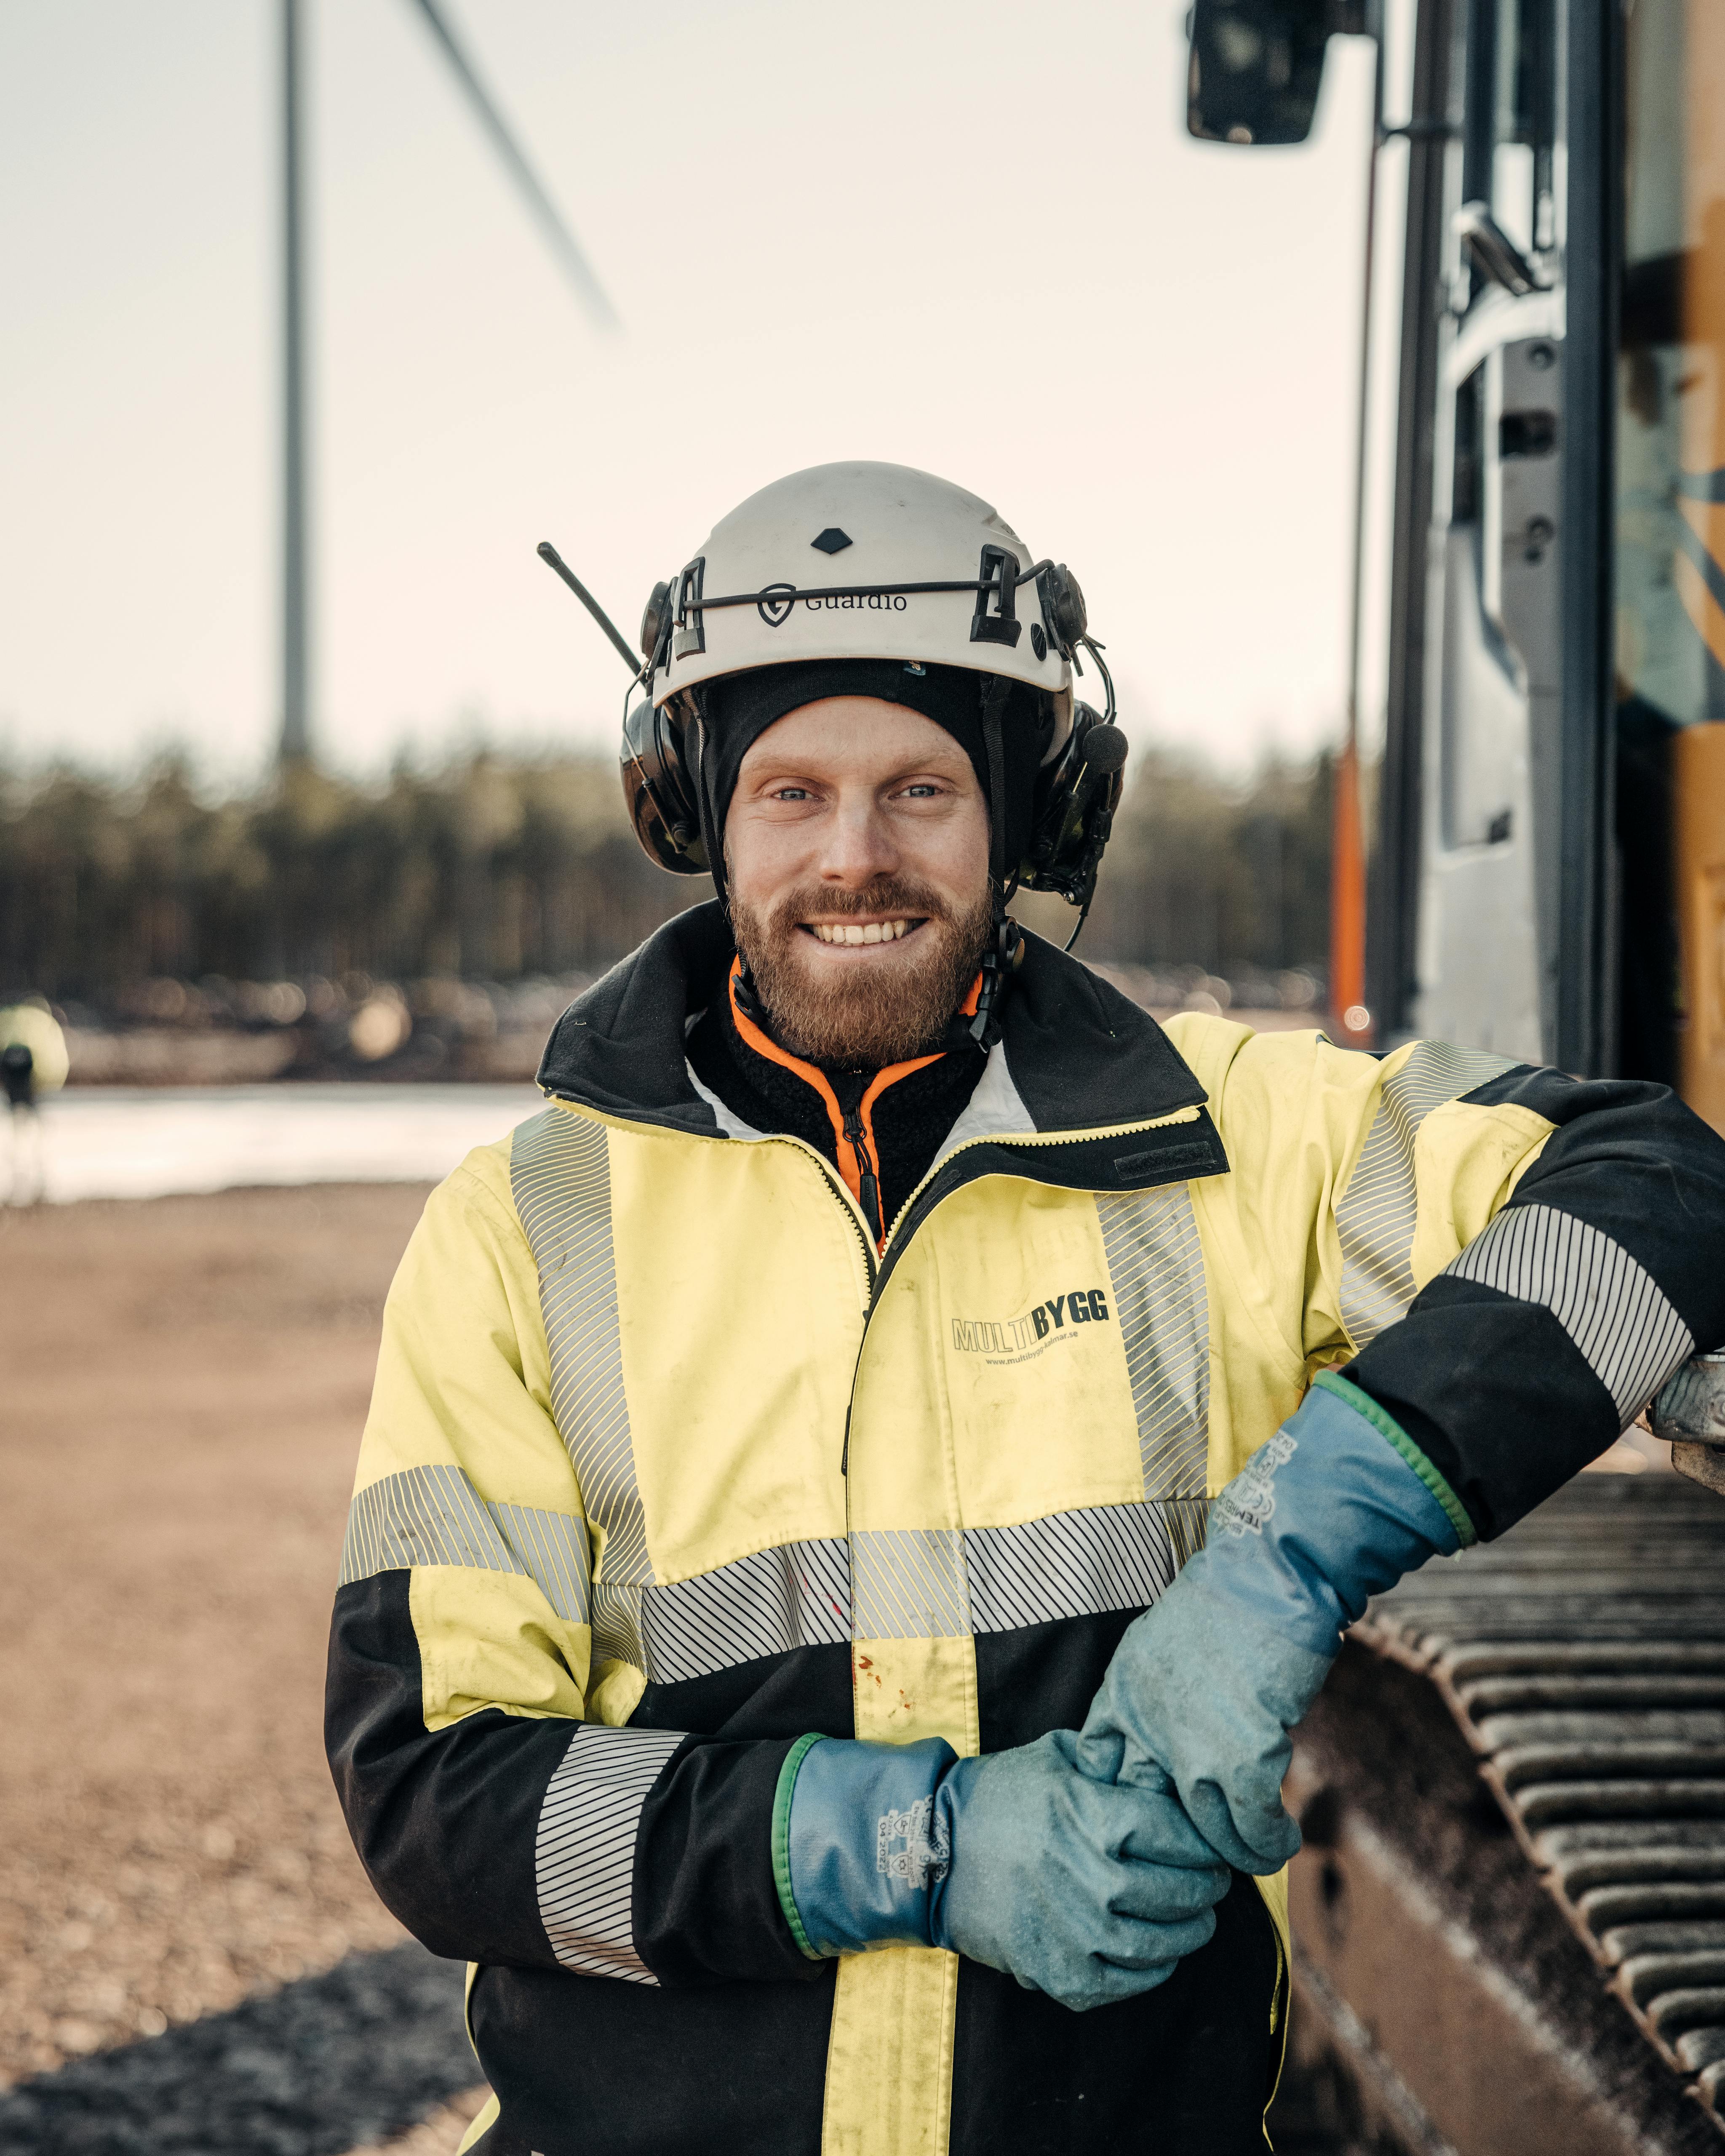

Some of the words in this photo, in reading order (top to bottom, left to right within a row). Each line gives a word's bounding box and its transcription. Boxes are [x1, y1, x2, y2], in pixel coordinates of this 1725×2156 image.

[805, 594, 907, 611] Guardio
[952, 1289, 1109, 1353] MULTIBYGG
[985, 1330, 1079, 1365] www.multibygg-kalmar.se
